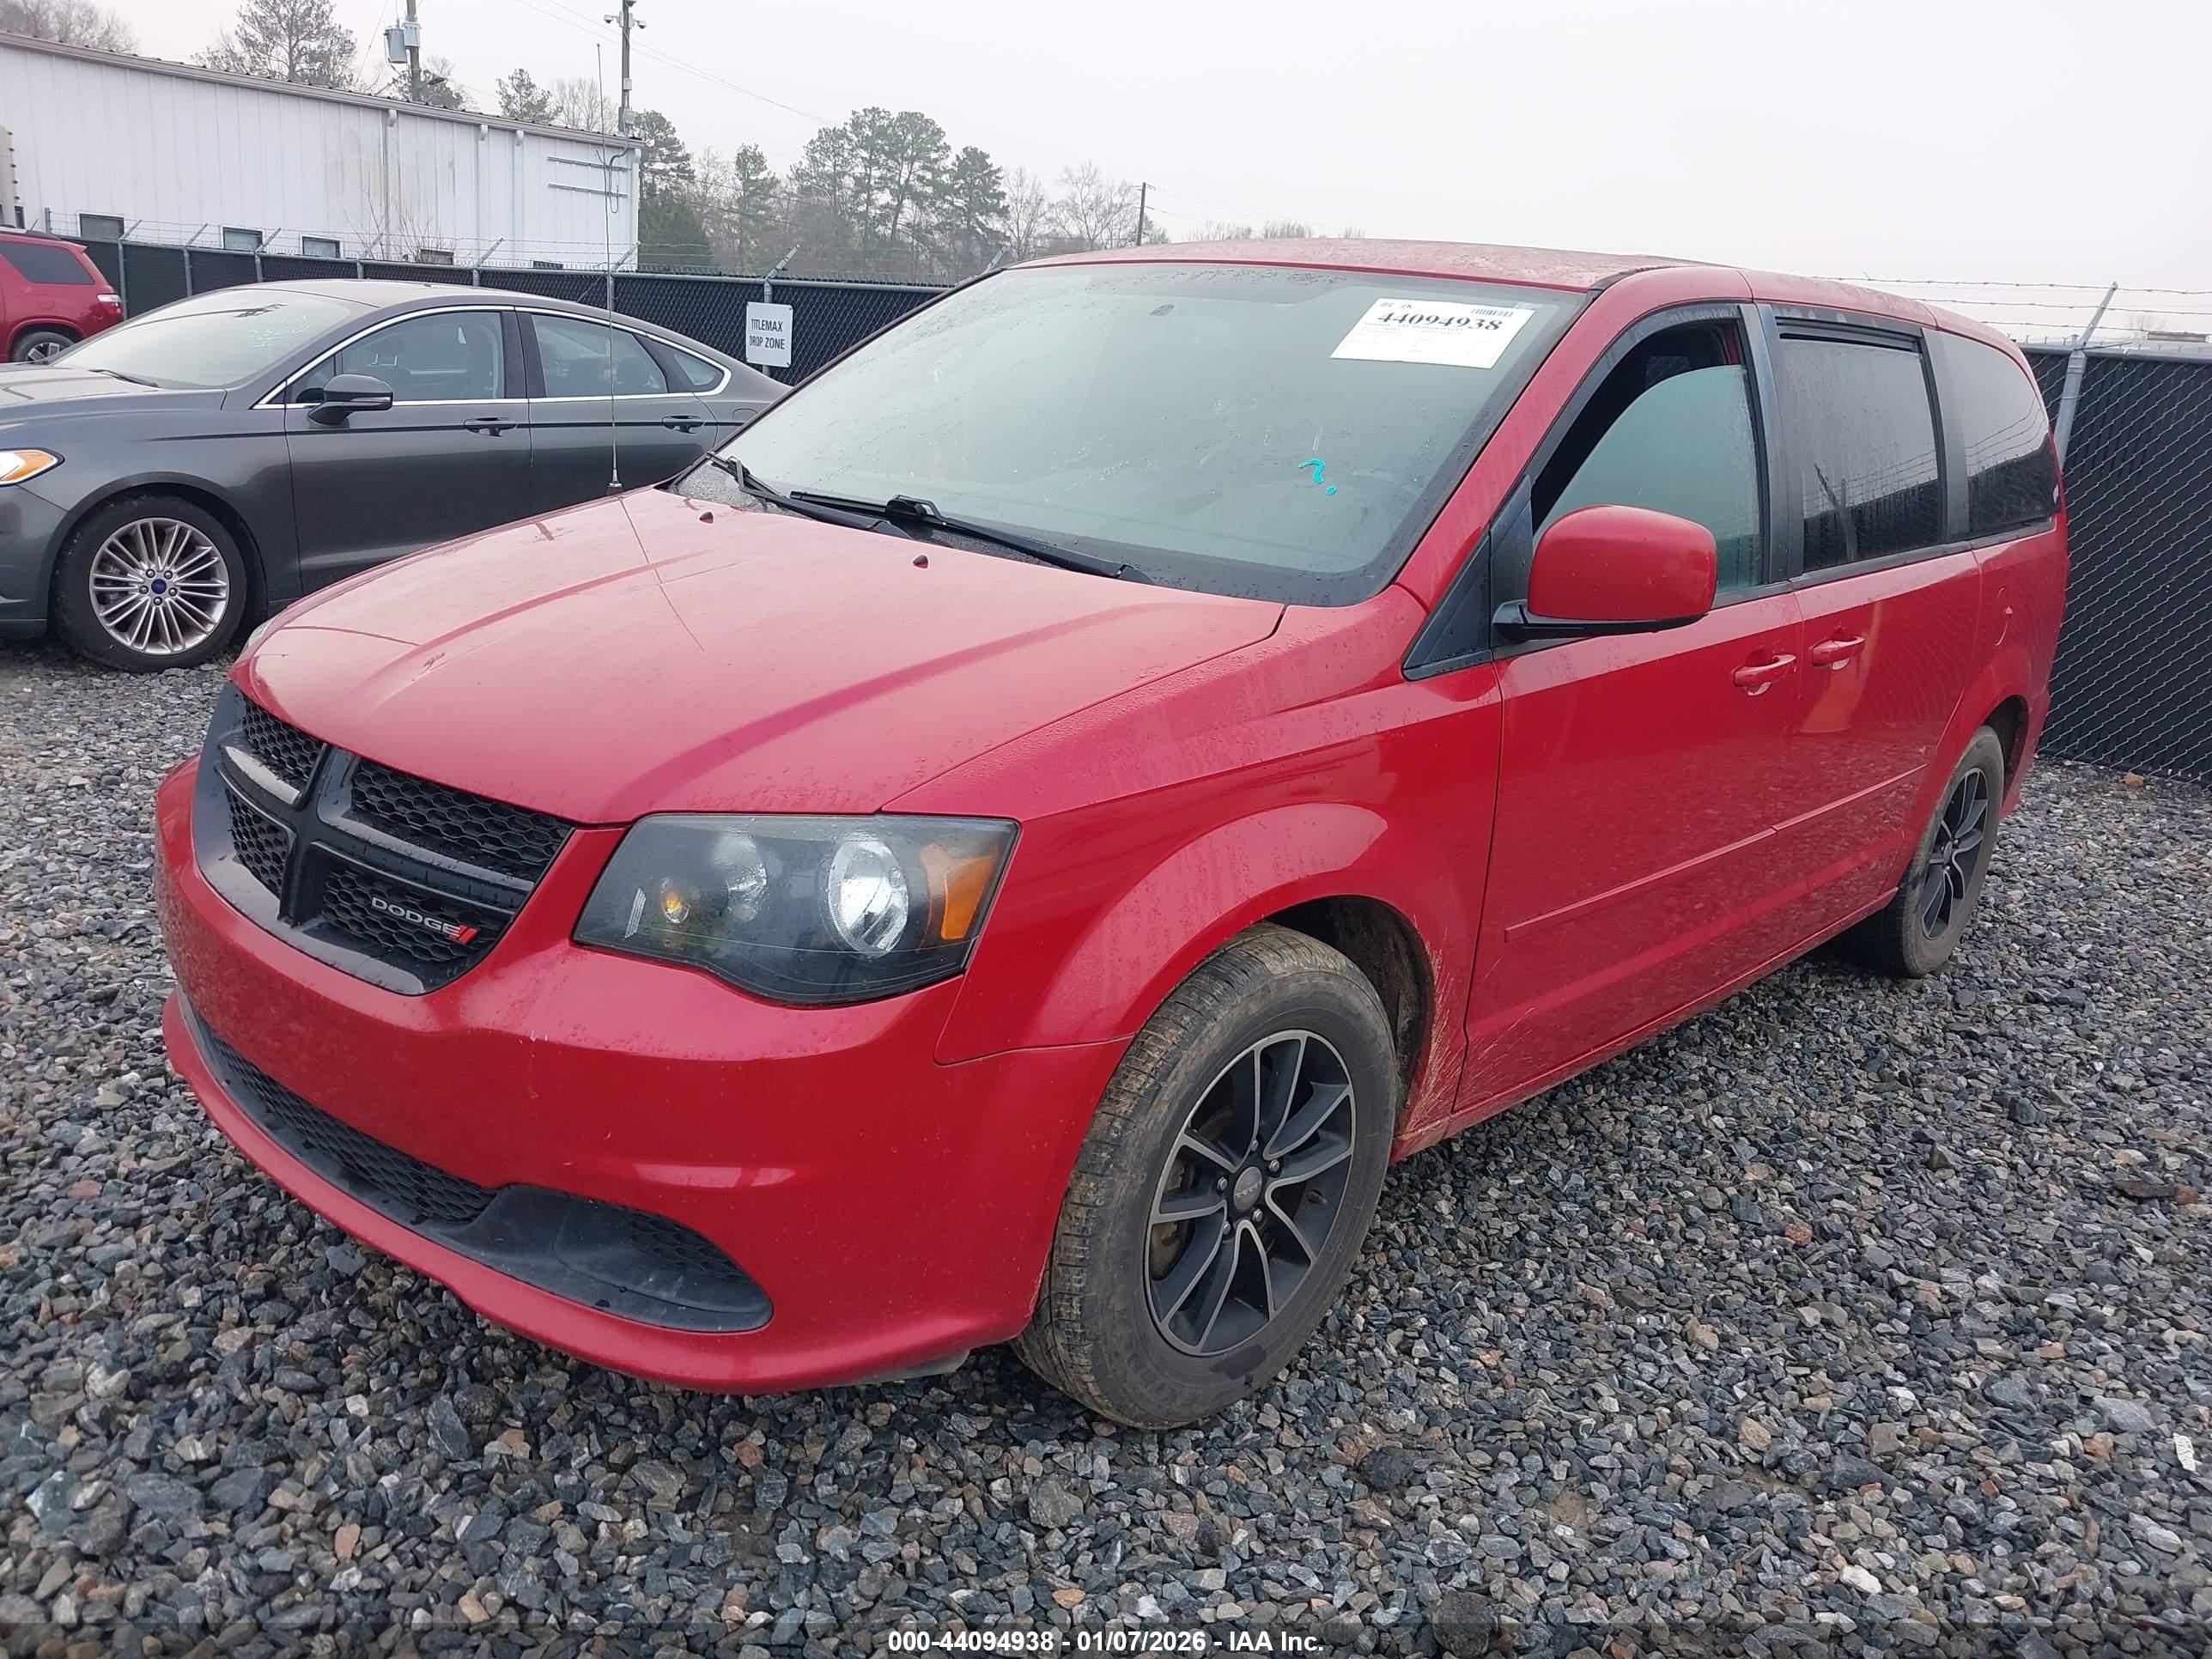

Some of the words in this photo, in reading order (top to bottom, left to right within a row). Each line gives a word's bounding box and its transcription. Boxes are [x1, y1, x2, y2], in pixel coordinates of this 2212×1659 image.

[750, 318, 783, 333] TITLEMAX
[1377, 311, 1503, 331] 44094938
[749, 335, 763, 348] DROP
[764, 337, 786, 350] ZONE
[371, 896, 461, 939] DODGE
